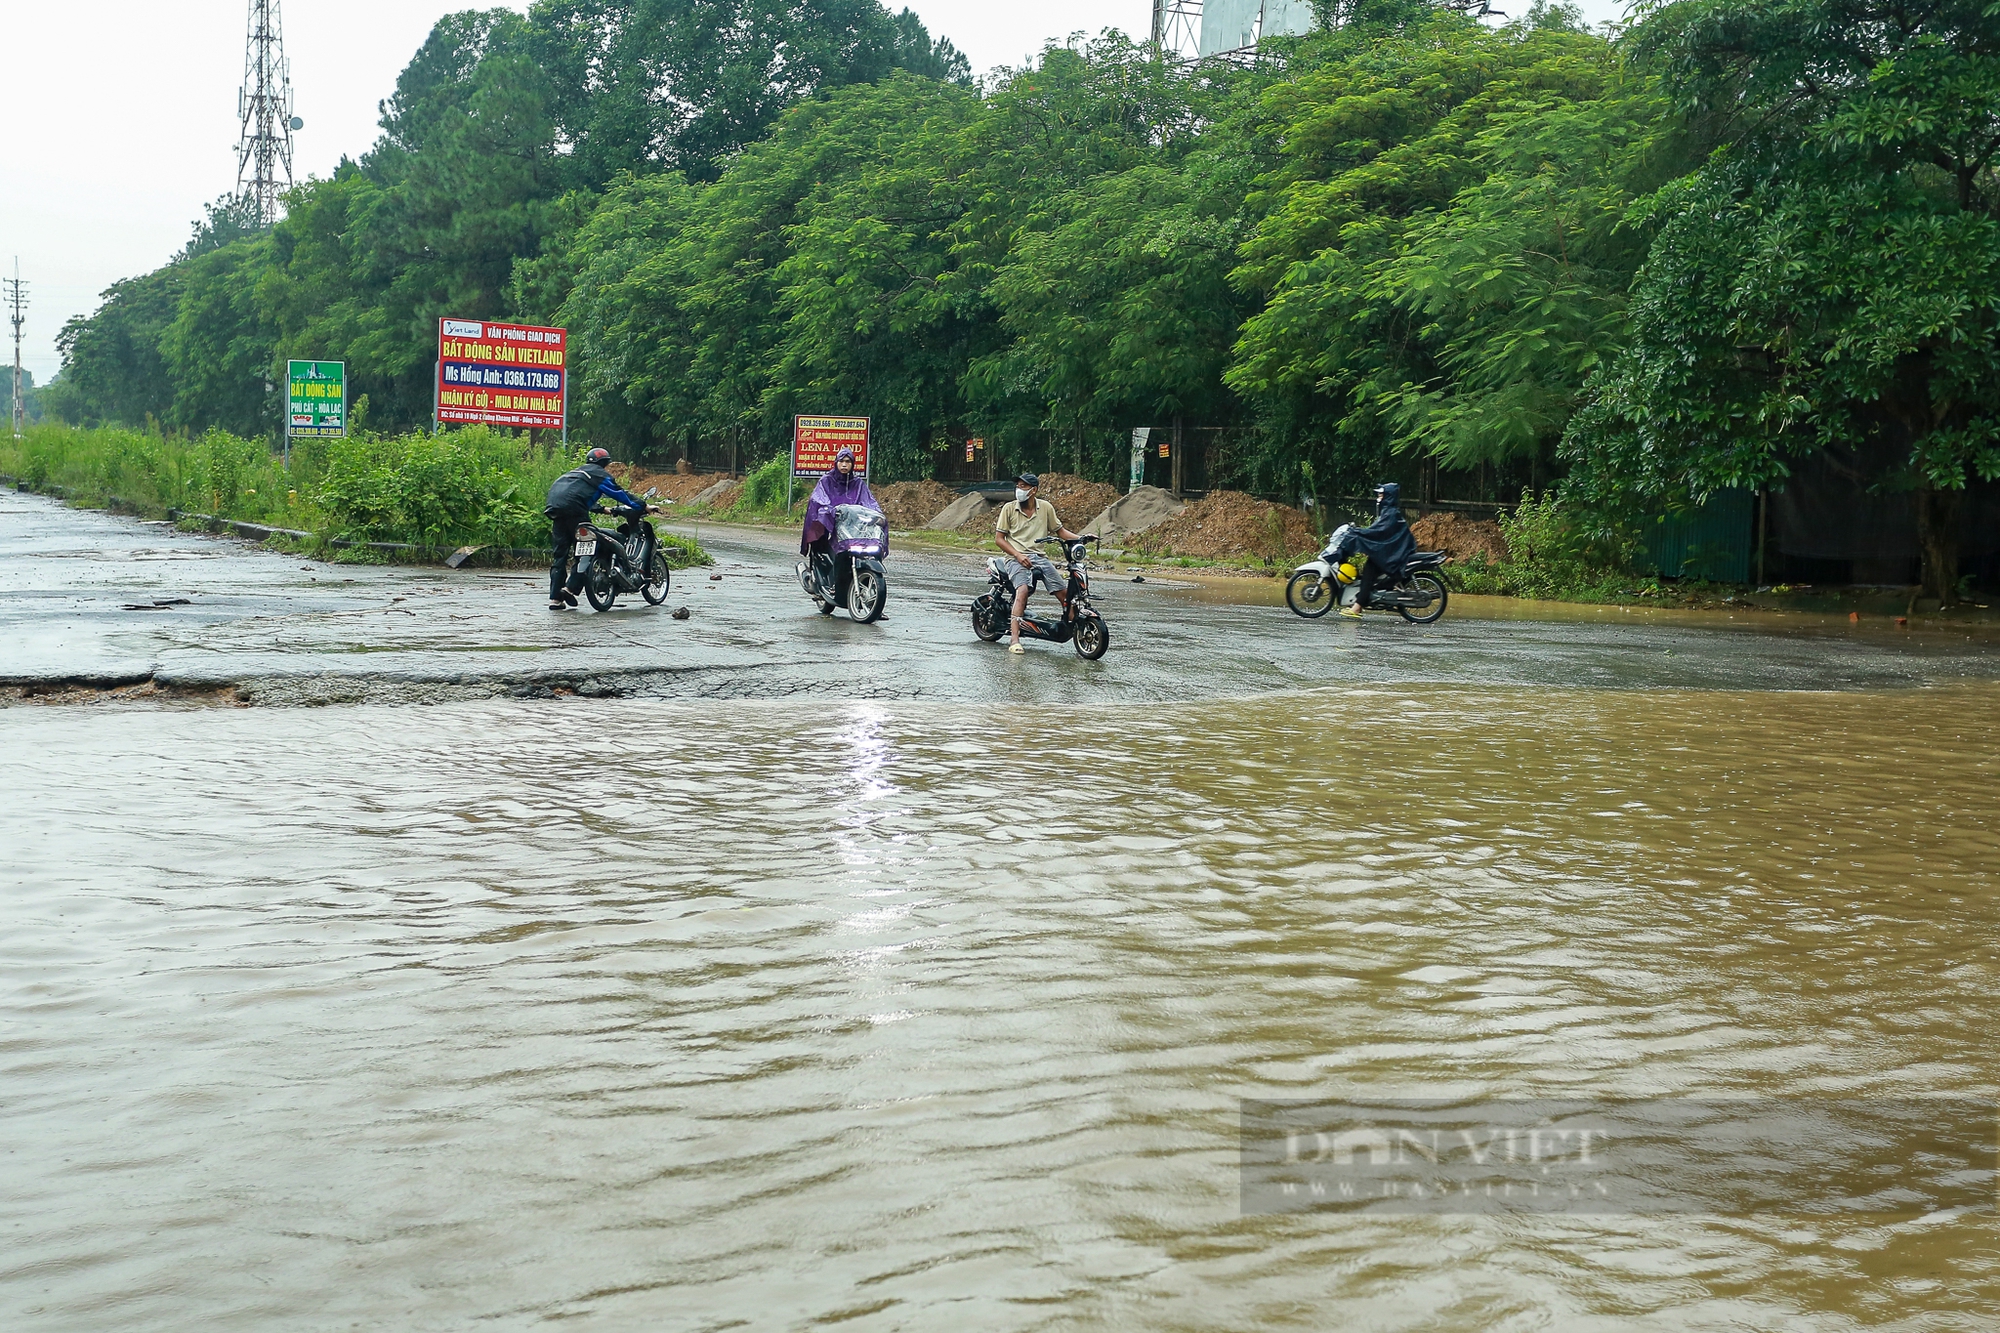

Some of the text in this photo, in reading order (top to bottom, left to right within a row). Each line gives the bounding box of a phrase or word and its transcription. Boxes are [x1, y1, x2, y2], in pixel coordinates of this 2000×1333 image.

[487, 326, 561, 345] VĂN PHÒNG GIAO DỊCH
[443, 337, 563, 365] BẤT ĐỘNG SẢN VIETLAND
[445, 365, 559, 389] Ms Hồng Anh: 0368.179.668
[441, 389, 462, 407] NHẬN
[464, 390, 474, 406] KÝ
[495, 395, 511, 409] MUA
[513, 394, 529, 410] BÁN
[530, 396, 545, 411] NHÀ
[547, 395, 562, 412] ĐẤT
[801, 443, 830, 451] LENA
